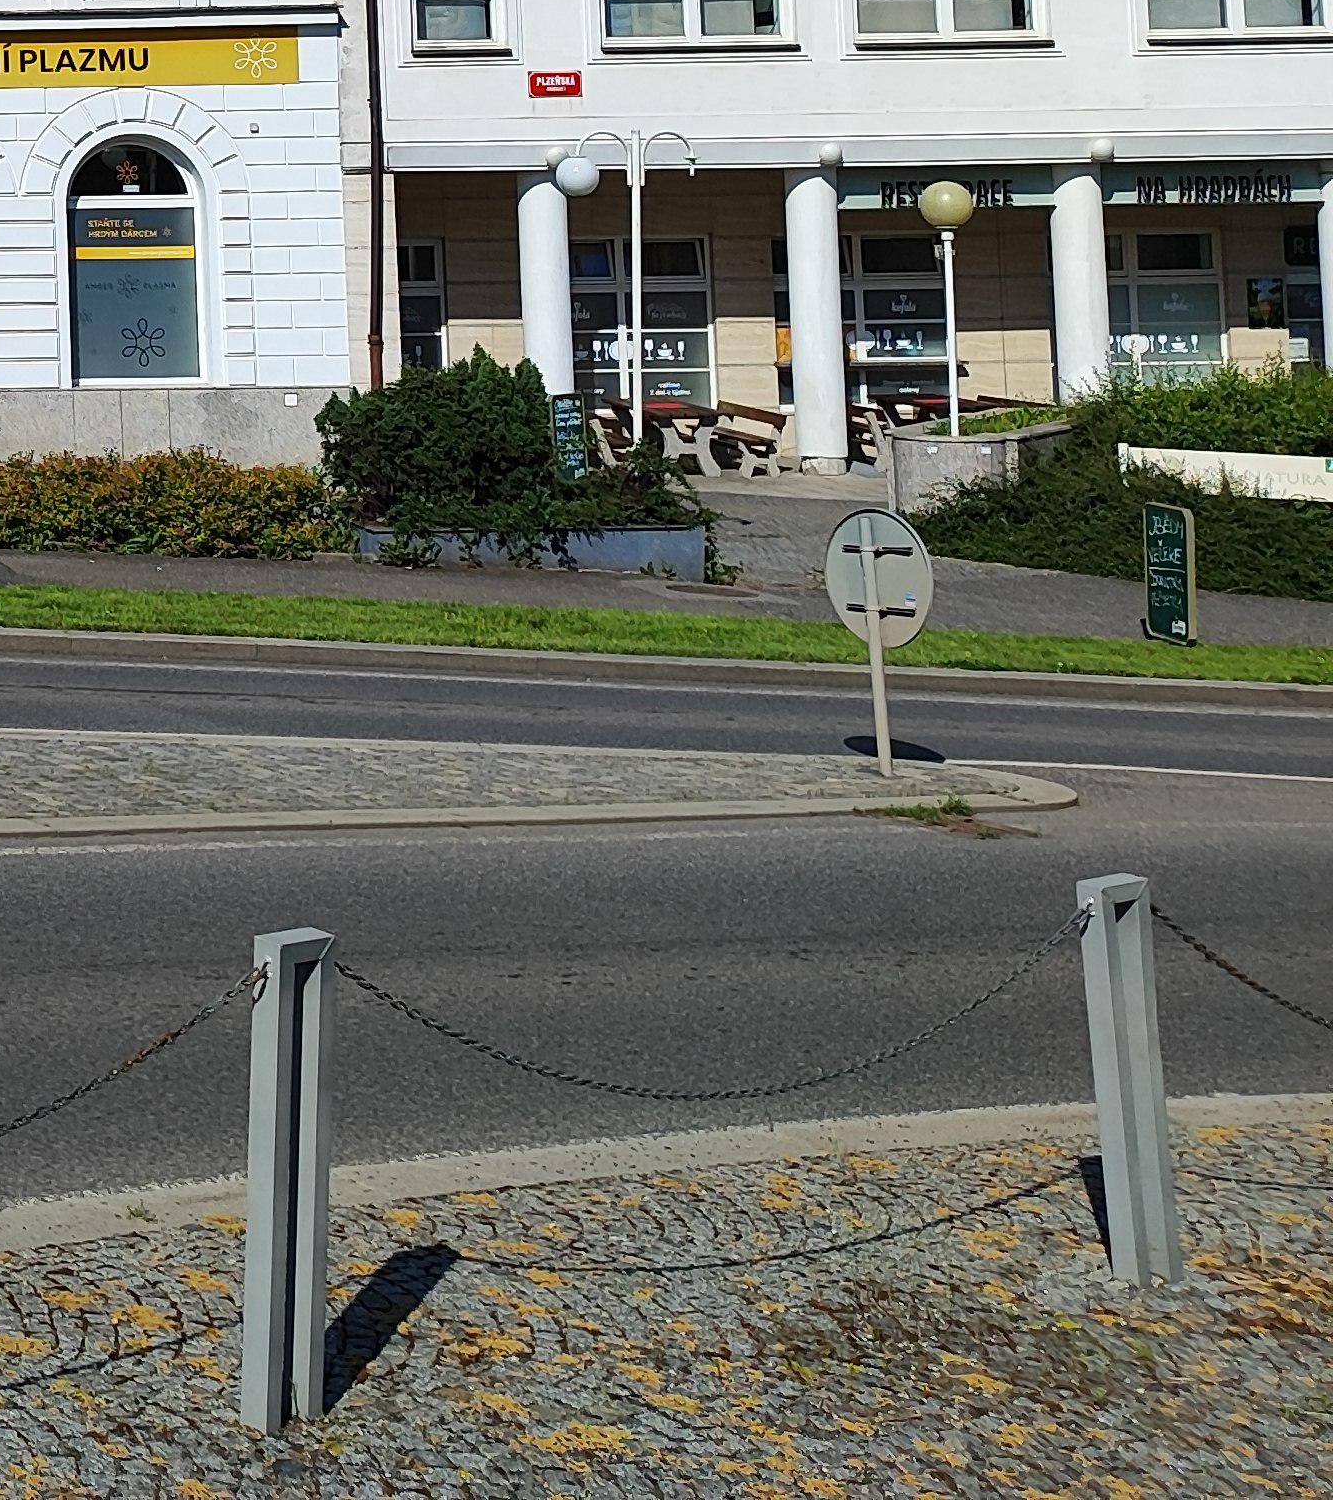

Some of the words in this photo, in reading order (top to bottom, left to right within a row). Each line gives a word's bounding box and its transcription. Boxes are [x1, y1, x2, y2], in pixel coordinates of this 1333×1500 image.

[20, 48, 150, 73] PLAZMU
[880, 179, 1014, 208] RESTACE
[1135, 176, 1166, 203] NA
[1178, 168, 1293, 204] HRADBÁCH
